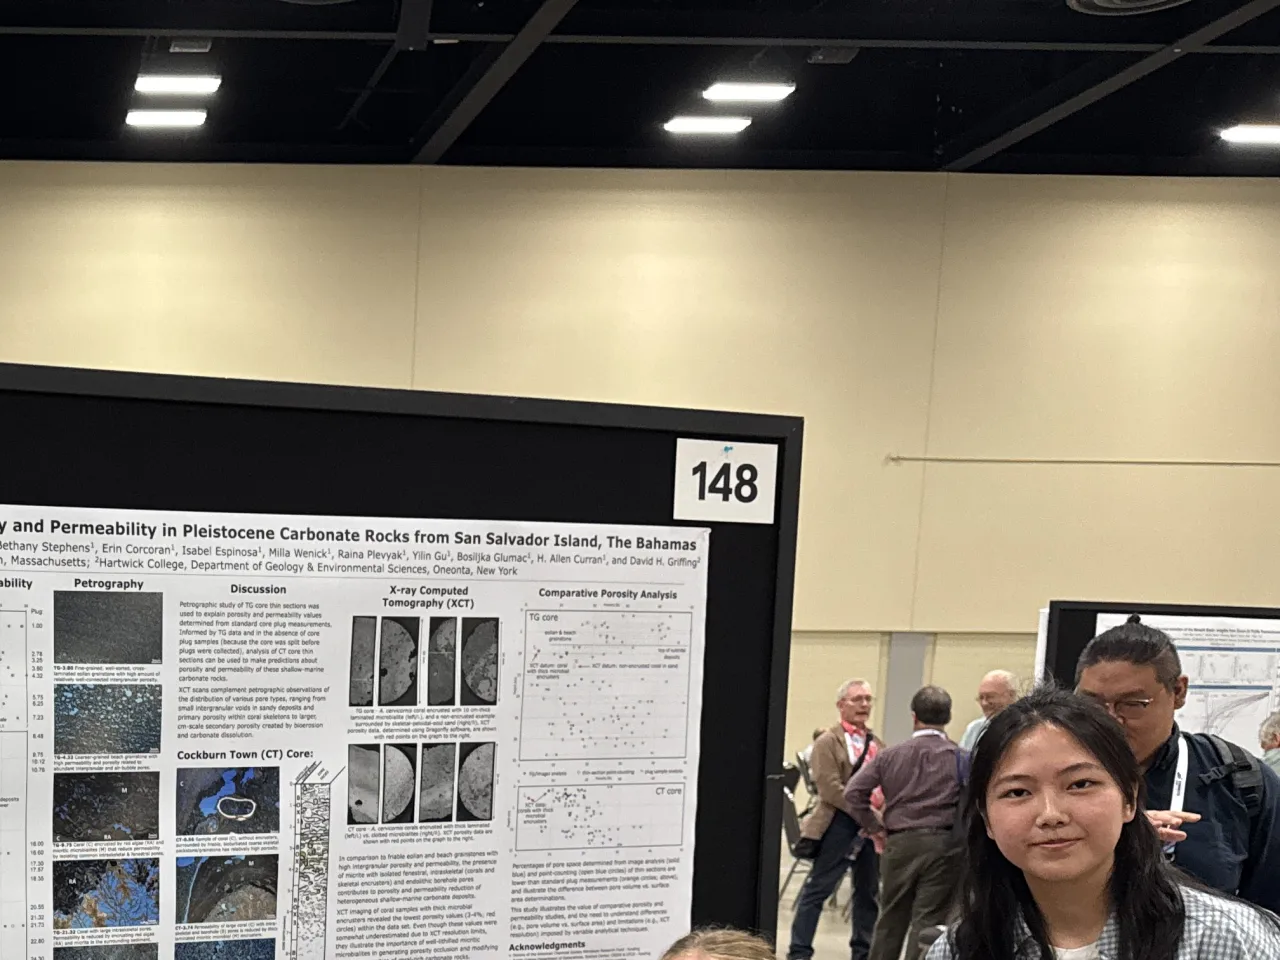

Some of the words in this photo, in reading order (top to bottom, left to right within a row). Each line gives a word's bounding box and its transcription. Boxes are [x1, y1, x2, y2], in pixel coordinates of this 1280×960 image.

[692, 461, 758, 503] 148
[12, 518, 44, 533] and
[50, 519, 156, 539] Permeability
[162, 522, 176, 537] in
[183, 523, 274, 540] Pleistocene
[279, 526, 360, 541] Carbonate
[365, 529, 409, 543] Rocks
[414, 529, 449, 544] from
[454, 531, 481, 544] San
[485, 532, 549, 546] Salvador
[553, 534, 601, 550] Island,
[606, 535, 632, 548] The
[636, 536, 696, 551] Bahamas
[102, 543, 122, 553] Erin
[182, 545, 211, 556] Isabel
[268, 547, 290, 557] Milla
[337, 549, 364, 559] Raina
[412, 550, 431, 560] Yilin
[456, 551, 491, 564] Bosiljka
[536, 553, 546, 563] H.
[549, 553, 571, 563] Allen
[611, 556, 627, 565] and
[629, 555, 654, 566] David
[655, 557, 664, 566] H.
[10, 555, 89, 568] Massachusetts;
[147, 558, 187, 571] College,
[190, 559, 249, 571] Department
[252, 560, 262, 570] of
[264, 561, 304, 574] Geology
[306, 562, 314, 572] &
[317, 562, 384, 573] Environmental
[387, 563, 430, 575] Sciences,
[432, 564, 473, 576] Oneonta,
[476, 565, 496, 575] New
[498, 566, 518, 575] York
[74, 578, 144, 590] Petrography
[230, 583, 286, 594] Discussion
[389, 585, 417, 596] X-ray
[419, 585, 468, 597] Computed
[538, 587, 598, 599] Comparative
[600, 589, 638, 600] Porosity
[640, 589, 677, 600] Analysis
[382, 597, 444, 609] Tomography
[446, 598, 474, 610] (XCT)
[529, 612, 540, 621] TG
[176, 750, 226, 760] Cockburn
[229, 750, 257, 759] Town
[260, 749, 283, 760] (CT)
[286, 749, 313, 758] Core:
[655, 788, 665, 796] CT
[508, 940, 585, 951] Acknowledgments
